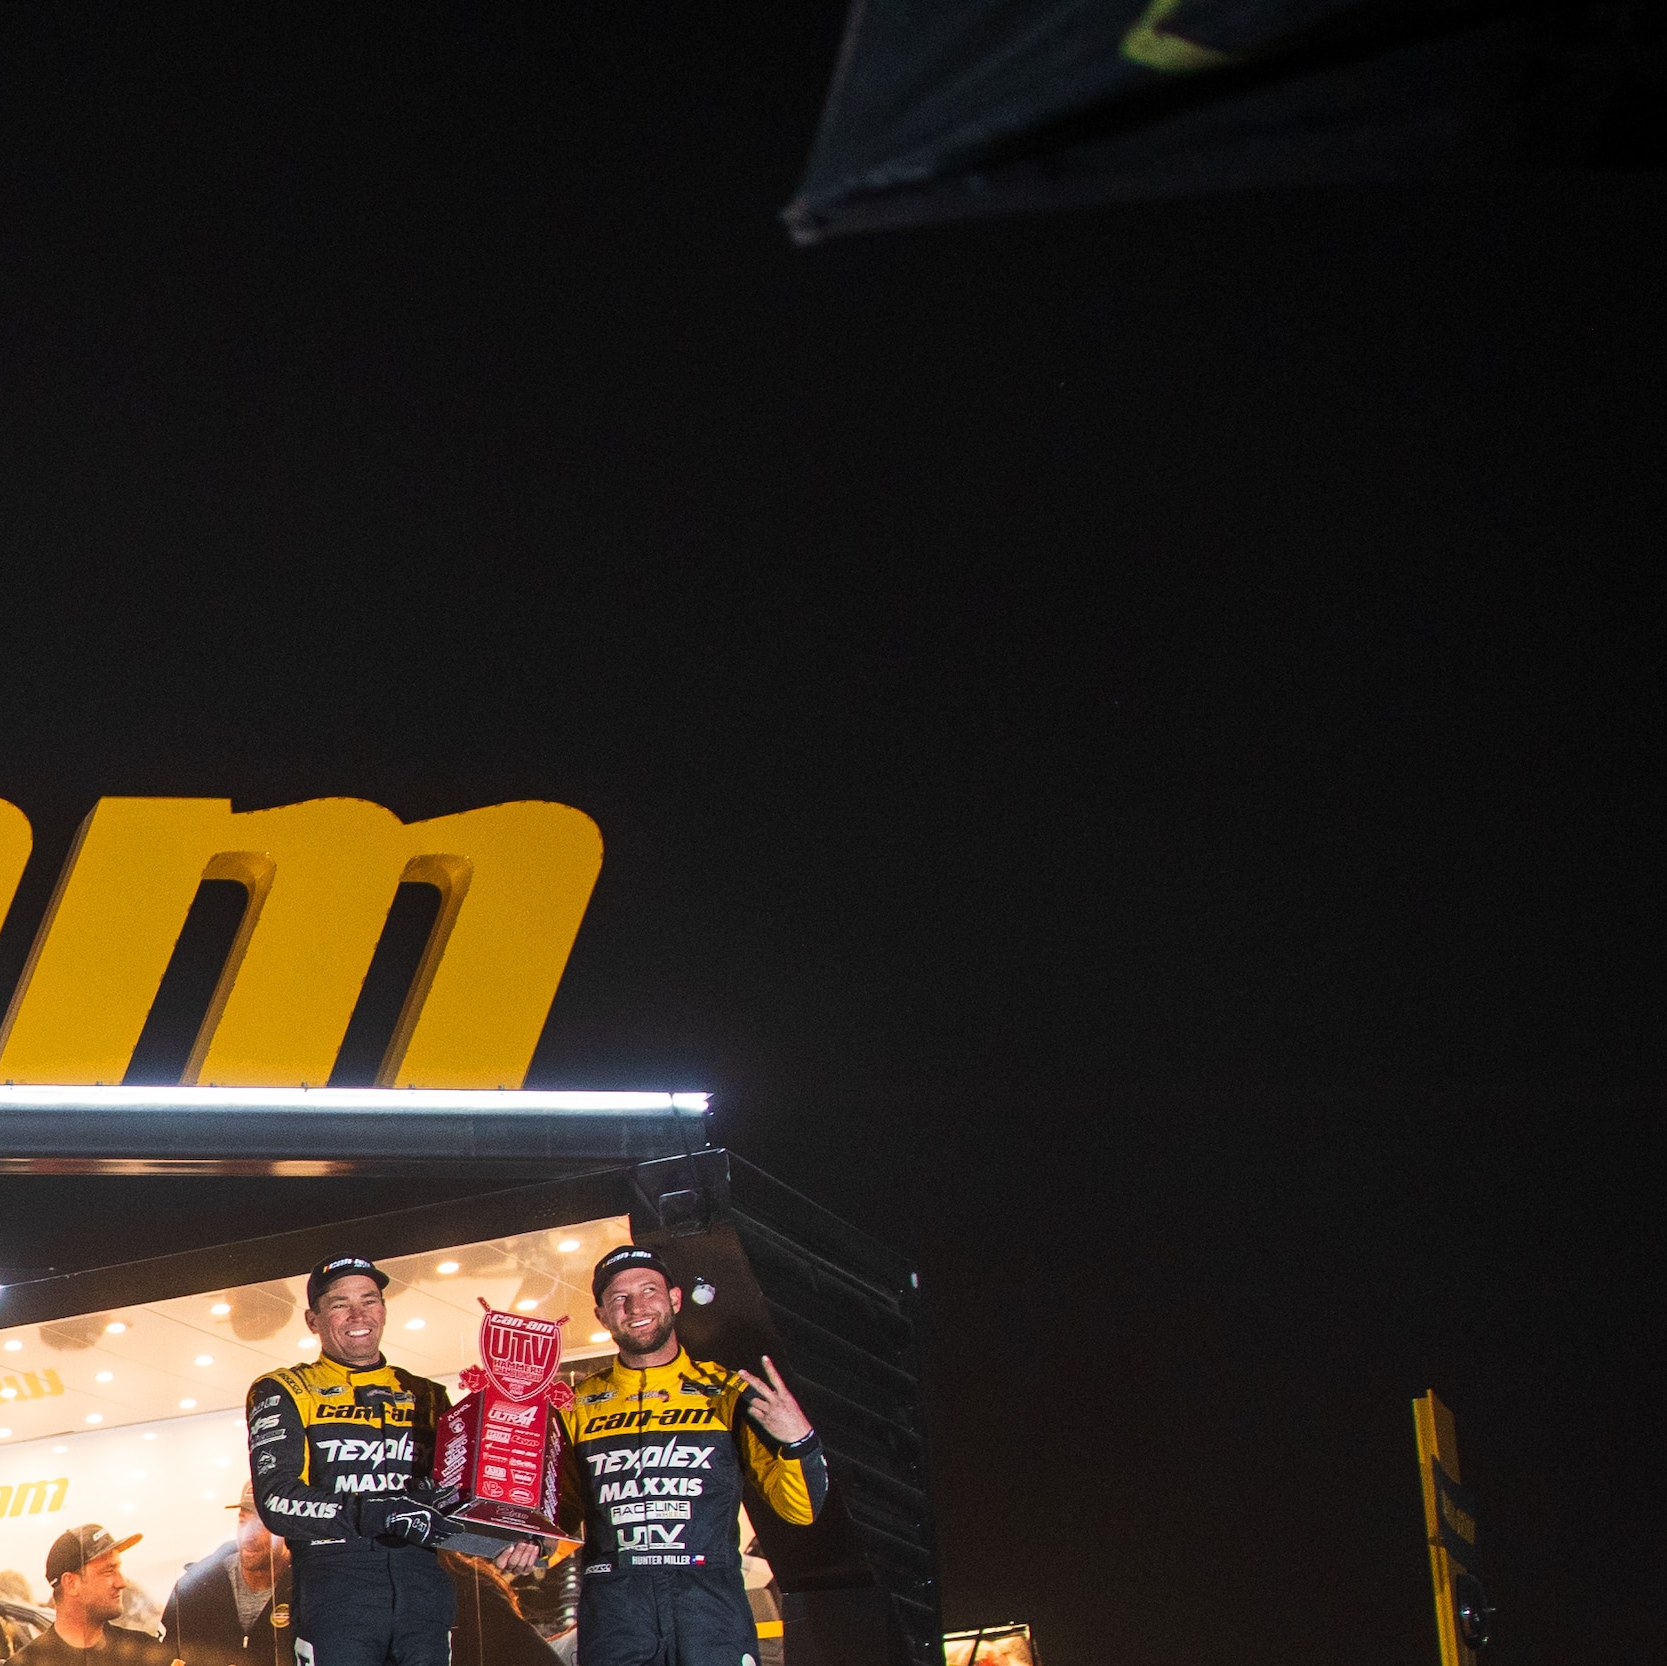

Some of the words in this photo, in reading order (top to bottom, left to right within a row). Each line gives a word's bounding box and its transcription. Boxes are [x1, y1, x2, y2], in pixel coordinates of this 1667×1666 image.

[491, 1312, 554, 1333] can-am
[489, 1326, 554, 1369] UTV
[493, 1359, 544, 1375] HAMMERS
[584, 1407, 717, 1434] can-am
[334, 1473, 412, 1494] MAXX
[599, 1477, 703, 1504] MAXXIS
[266, 1493, 342, 1519] MAXXIS
[612, 1503, 688, 1517] RACELINE
[631, 1555, 662, 1565] HUNTER
[663, 1555, 691, 1565] MILLER
